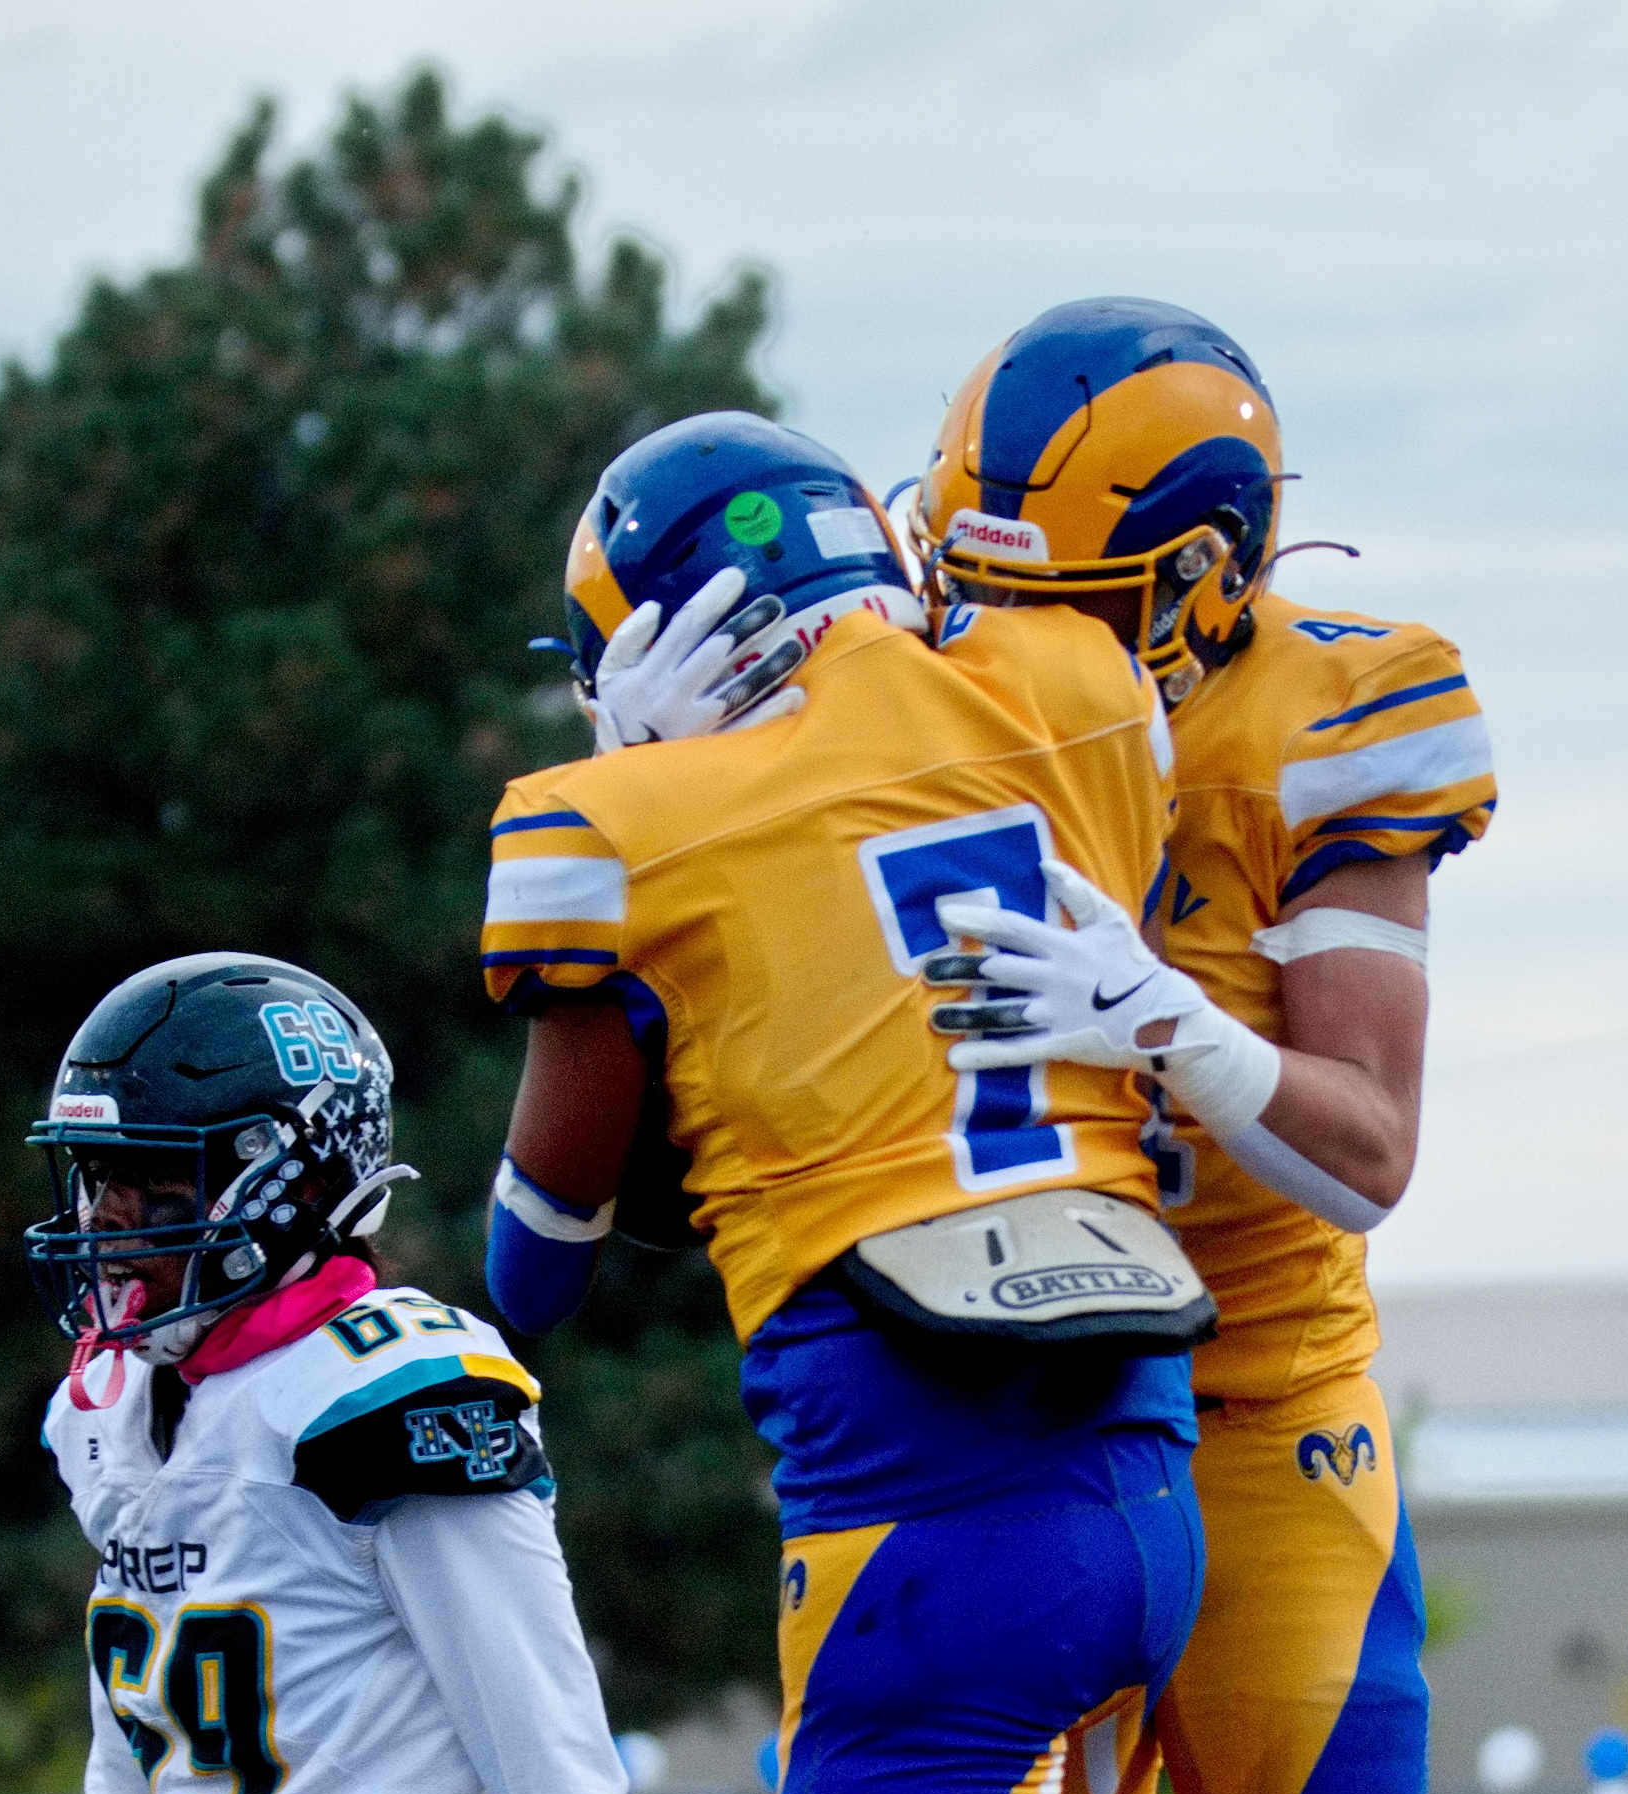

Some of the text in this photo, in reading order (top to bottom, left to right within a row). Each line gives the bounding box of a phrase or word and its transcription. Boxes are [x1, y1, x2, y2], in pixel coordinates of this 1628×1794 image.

[858, 802, 1081, 1193] 7
[258, 1000, 362, 1087] 69
[1008, 1271, 1160, 1301] BATTLE
[100, 1539, 207, 1593] PREP
